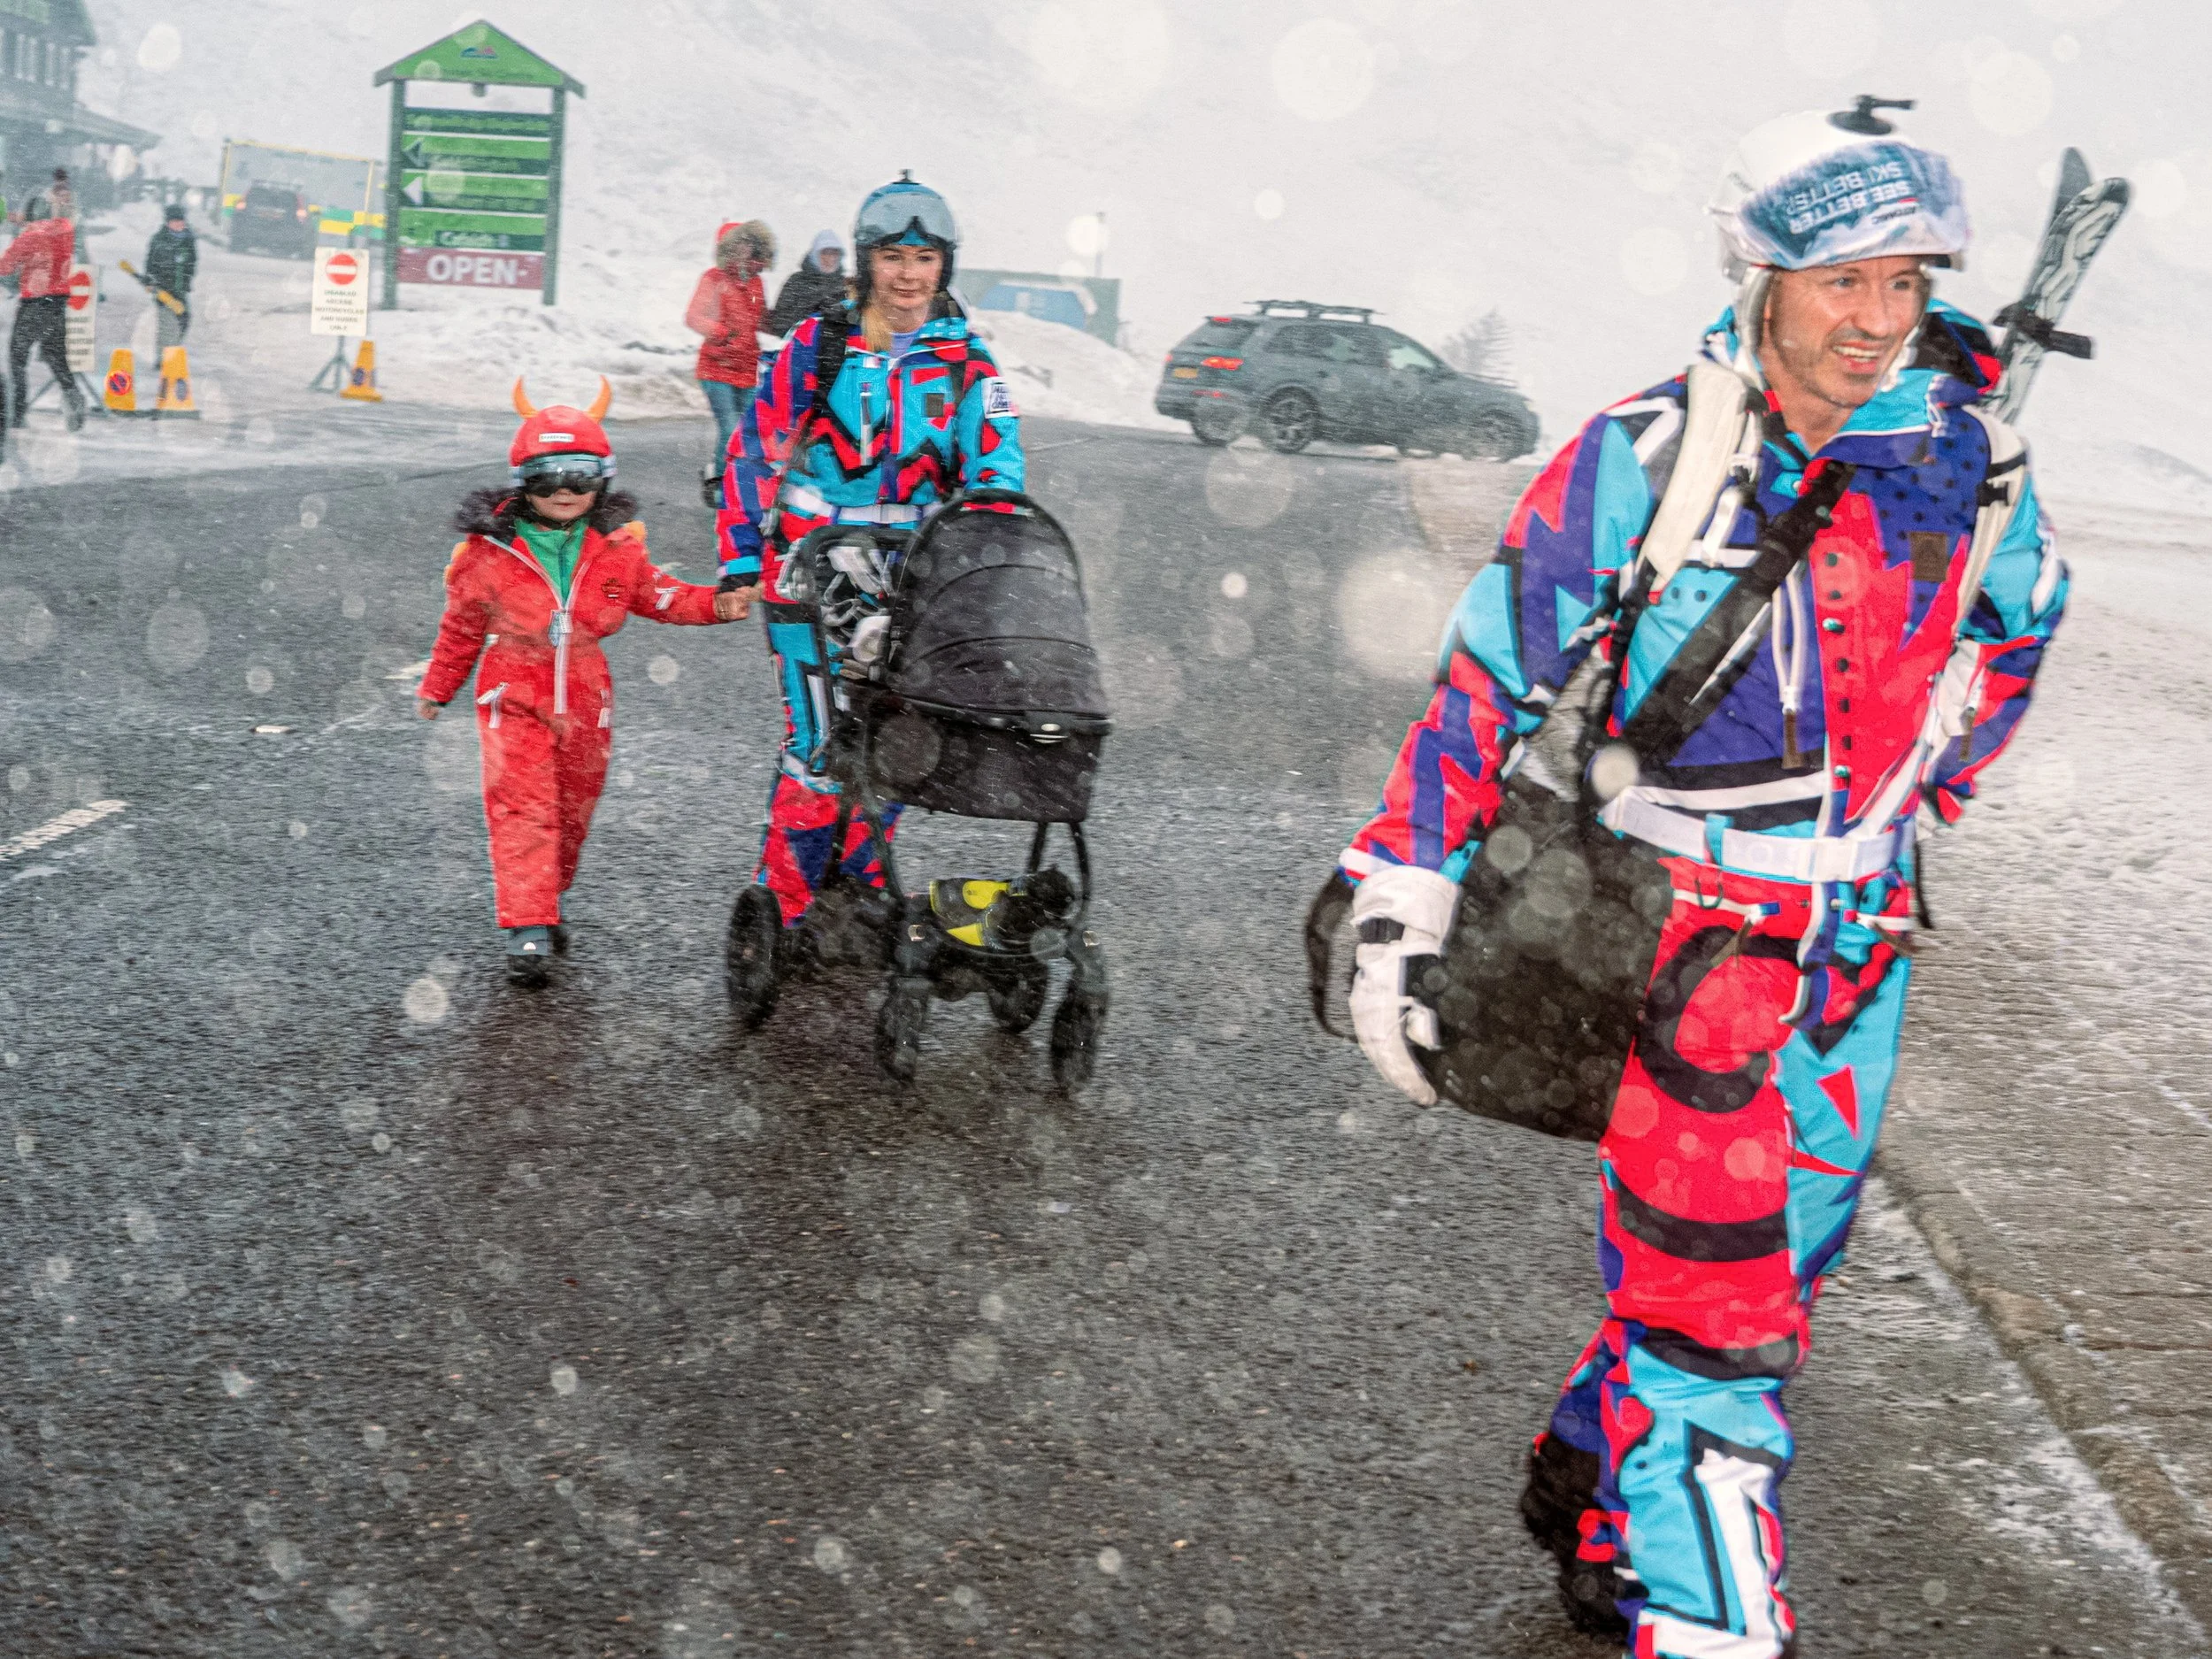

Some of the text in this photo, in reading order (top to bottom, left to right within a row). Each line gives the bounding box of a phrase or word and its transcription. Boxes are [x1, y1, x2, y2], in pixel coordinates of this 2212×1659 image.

[1865, 161, 1902, 183] SKI
[1787, 171, 1865, 216] BETTER
[1789, 180, 1911, 235] SEE BETTER
[426, 254, 518, 285] OPEN
